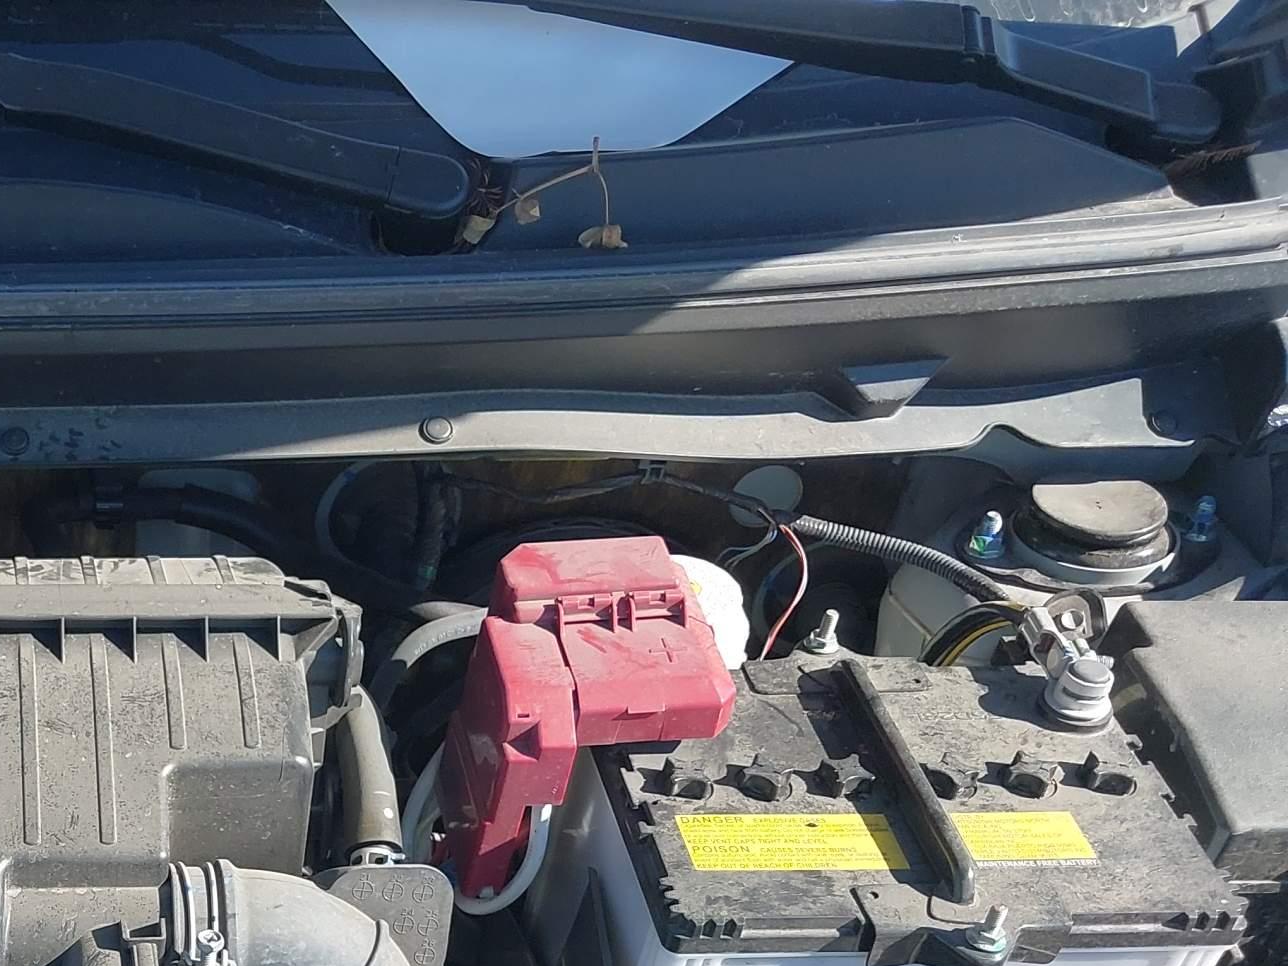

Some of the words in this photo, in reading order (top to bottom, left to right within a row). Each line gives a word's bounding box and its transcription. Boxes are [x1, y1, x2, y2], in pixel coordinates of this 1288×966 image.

[679, 816, 745, 824] DANGER
[692, 845, 751, 854] POISON
[976, 860, 1036, 868] MAINTENANCE
[1059, 859, 1100, 867] BATTERY
